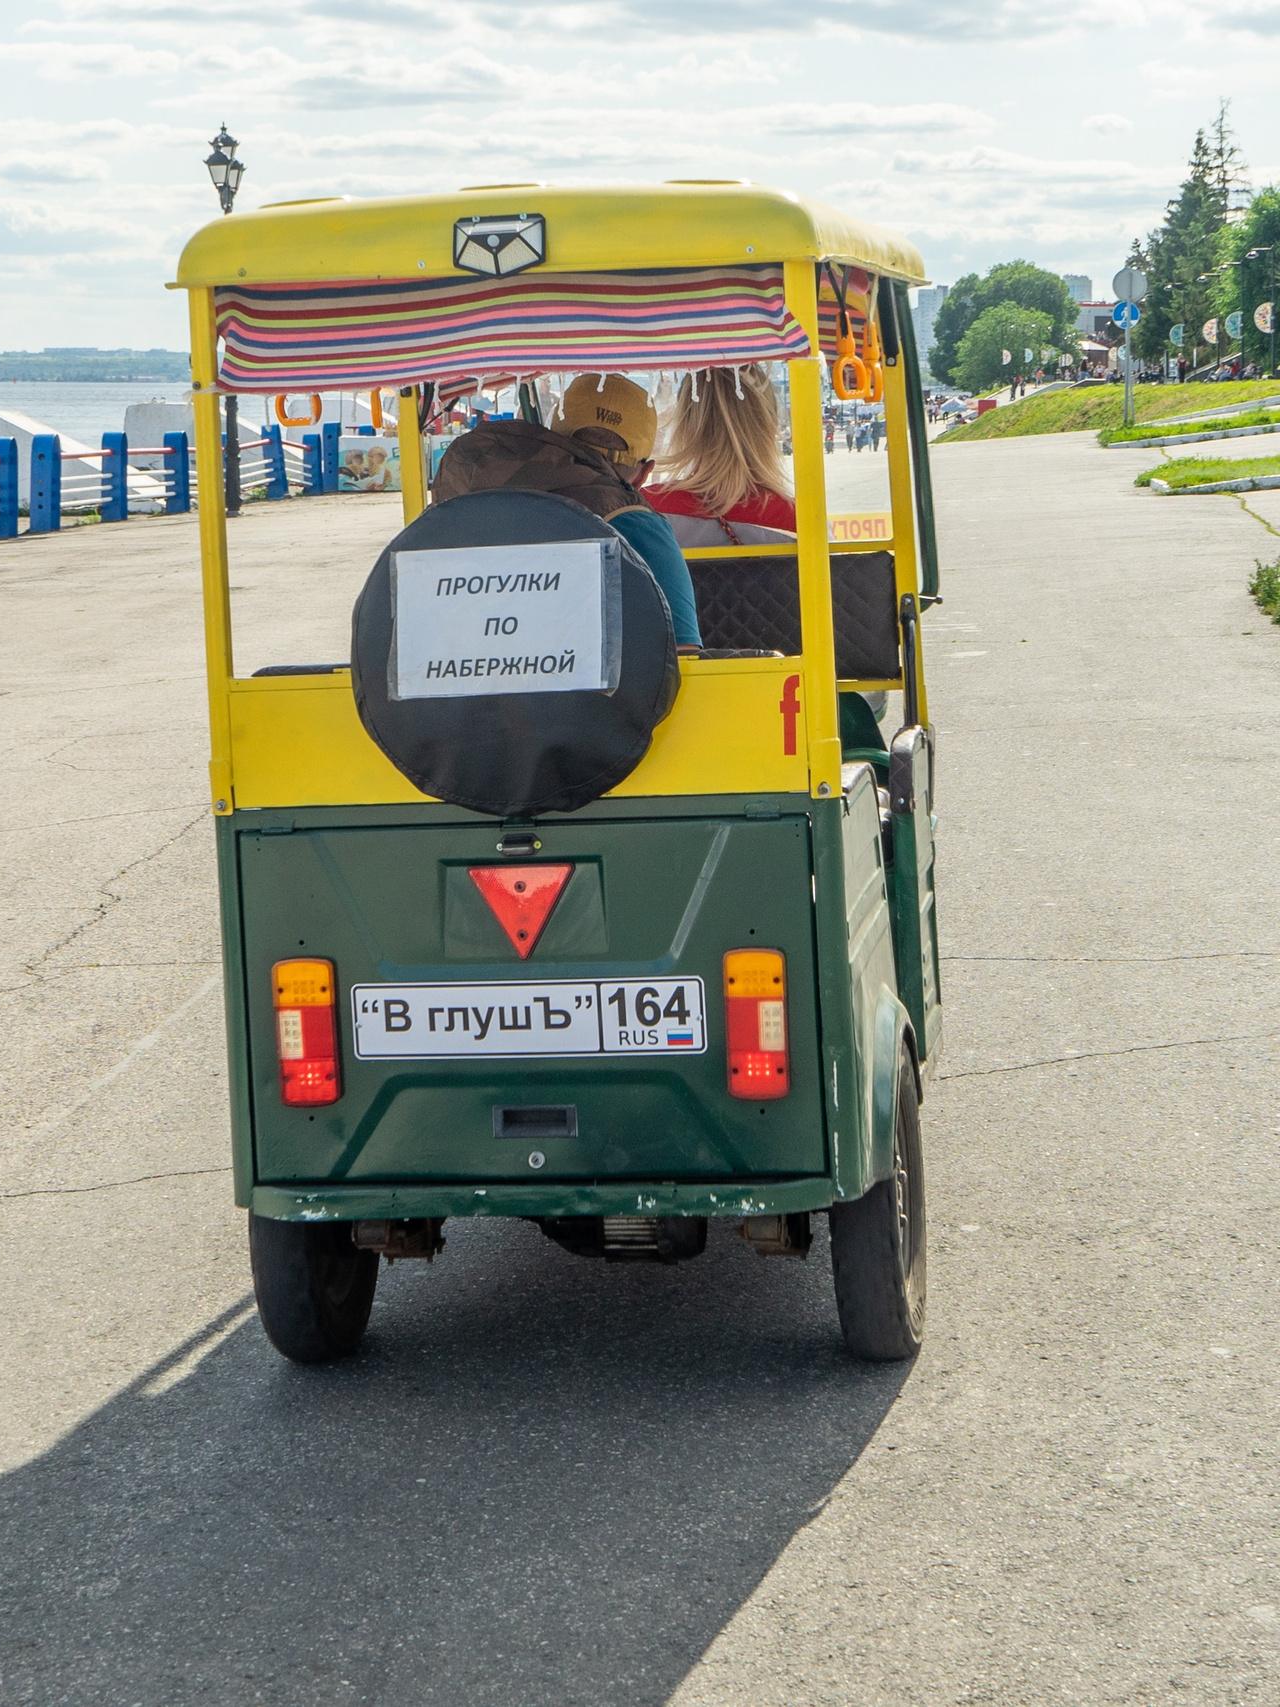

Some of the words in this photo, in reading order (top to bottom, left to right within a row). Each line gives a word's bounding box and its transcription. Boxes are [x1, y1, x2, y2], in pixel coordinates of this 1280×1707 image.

[436, 572, 561, 597] ПРОГУЛКИ
[484, 616, 519, 636] ПО
[426, 649, 576, 679] НАБЕРЖНОЙ
[779, 675, 800, 756] f
[607, 985, 691, 1027] 164
[618, 1029, 659, 1047] RUS
